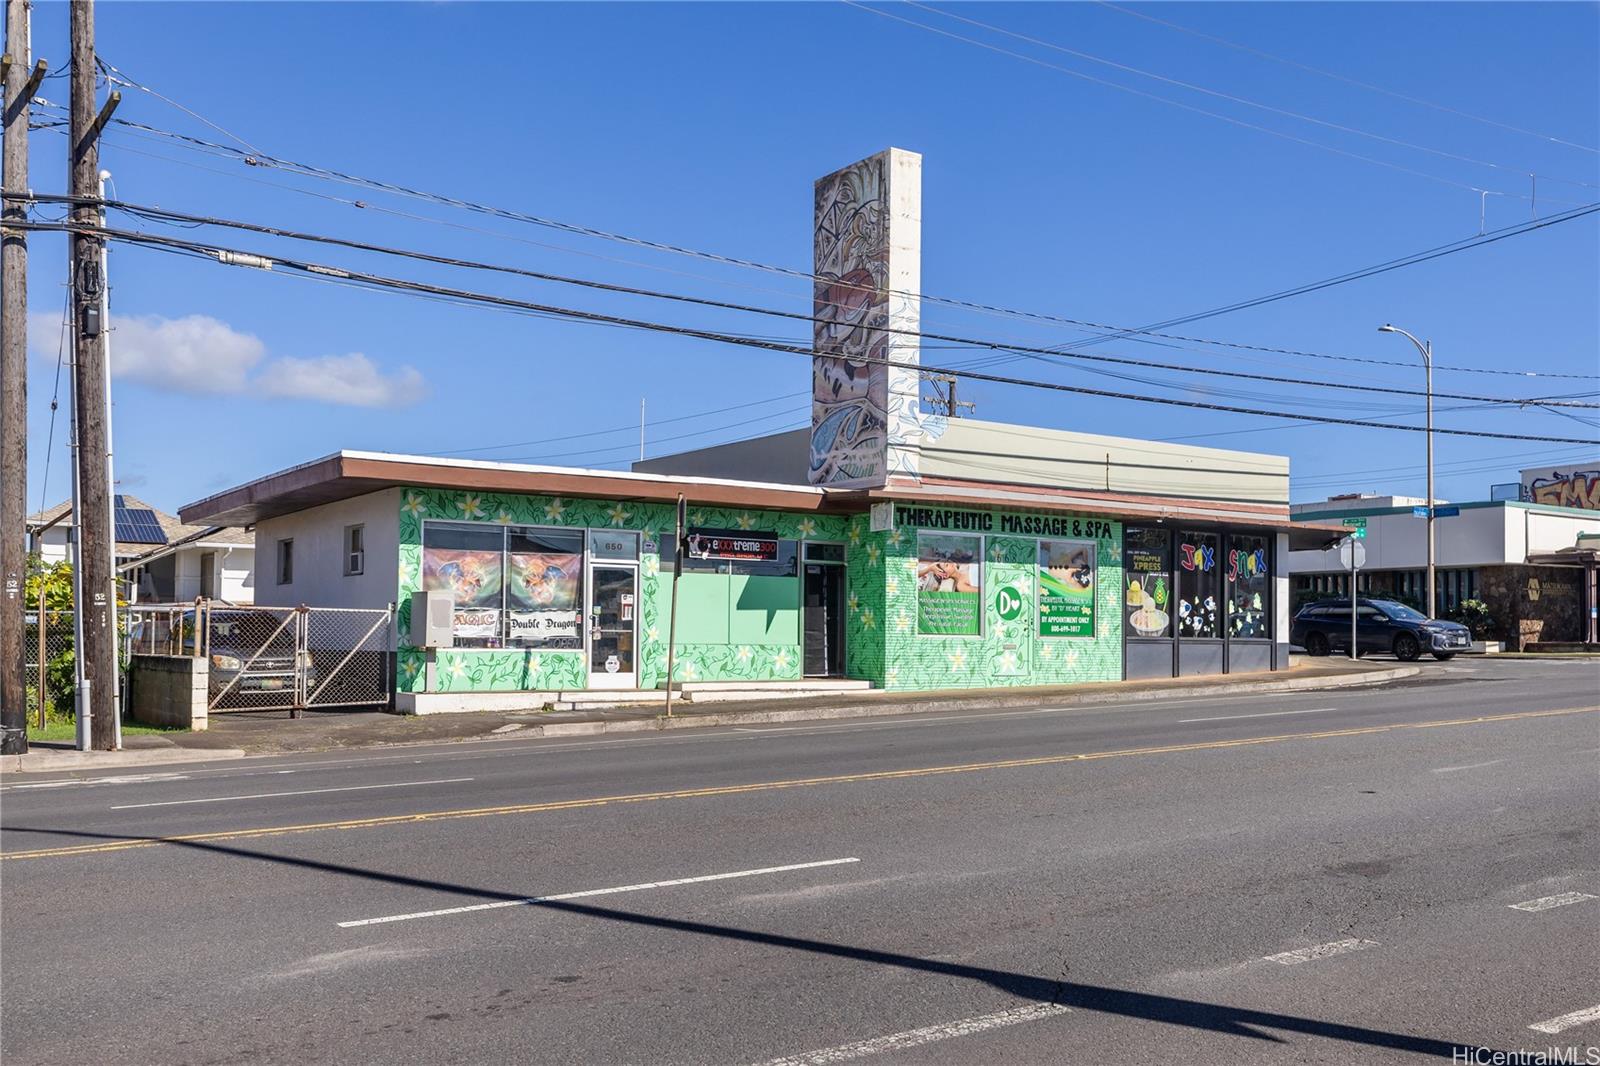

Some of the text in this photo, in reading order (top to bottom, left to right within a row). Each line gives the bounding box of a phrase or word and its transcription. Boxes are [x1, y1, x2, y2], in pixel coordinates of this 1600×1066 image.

[896, 507, 1113, 540] THERAPEUTIC MASSAGE & SPA
[605, 543, 624, 552] 650
[996, 553, 1018, 563] 668
[1133, 562, 1162, 571] XPRESS
[7, 580, 18, 588] 52
[94, 593, 106, 601] 52
[1000, 591, 1011, 615] D
[454, 614, 495, 626] AGIC
[511, 618, 576, 630] Double Dragon
[552, 638, 581, 649] OPEN
